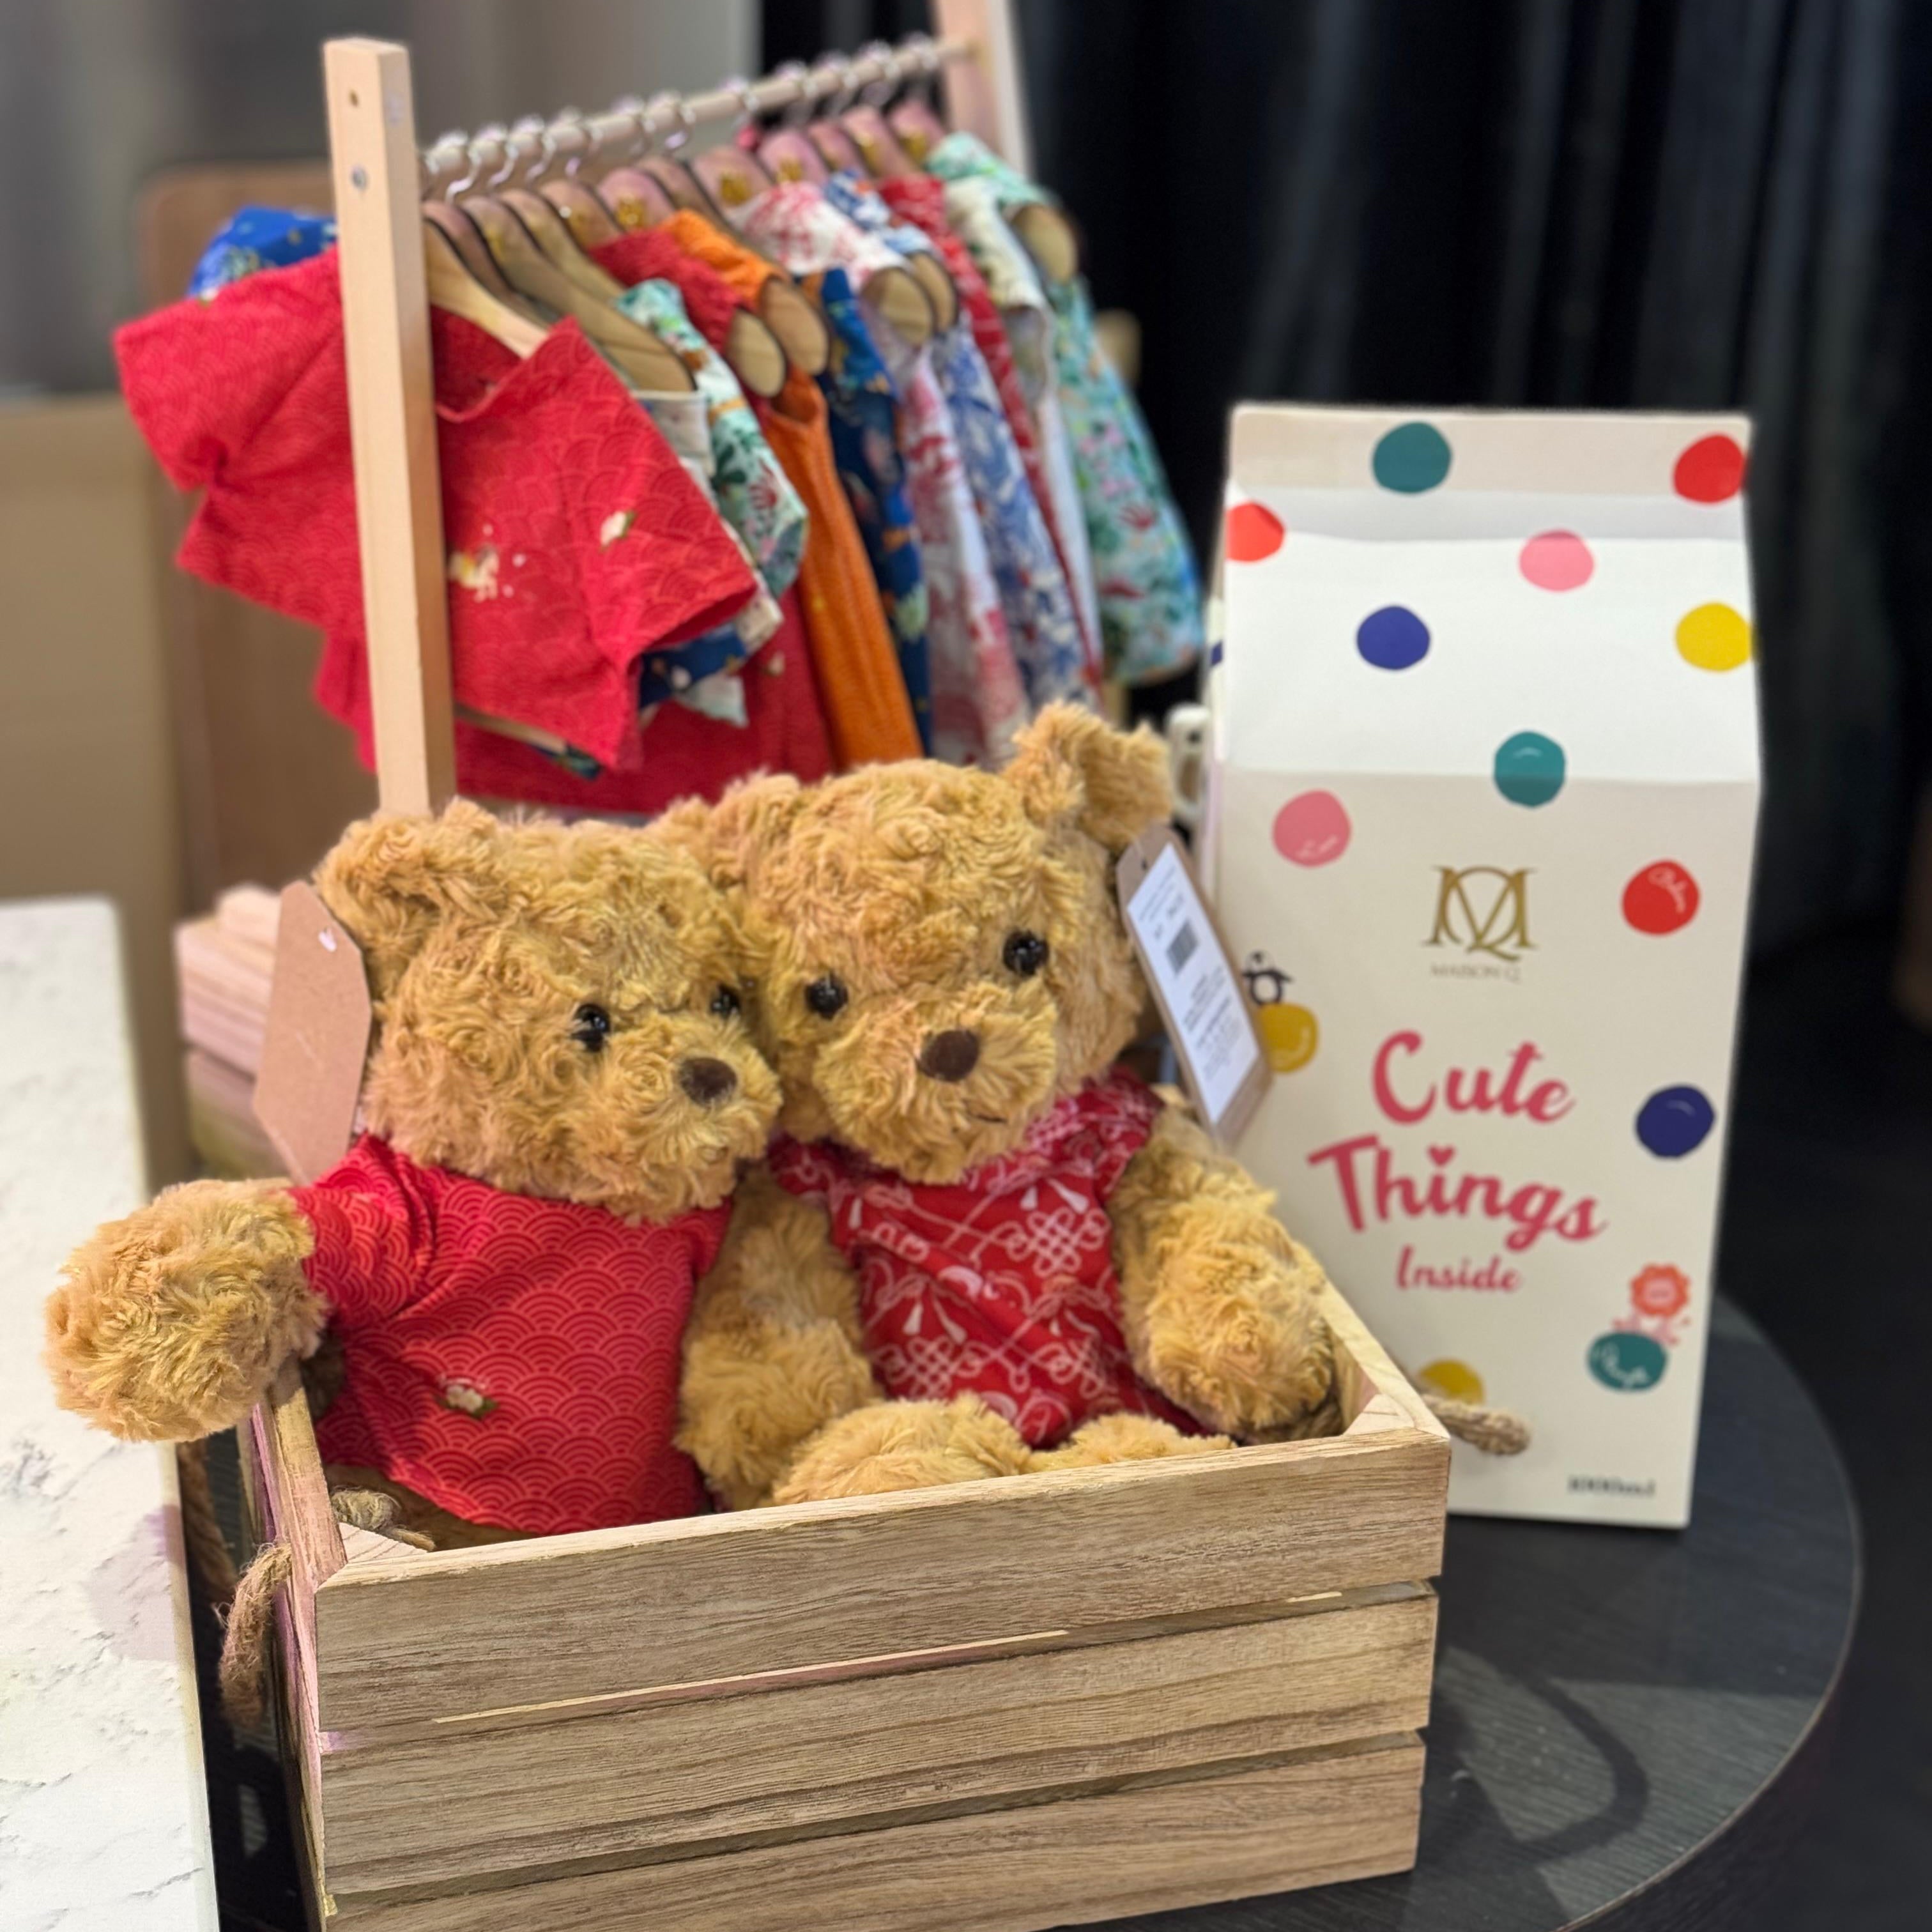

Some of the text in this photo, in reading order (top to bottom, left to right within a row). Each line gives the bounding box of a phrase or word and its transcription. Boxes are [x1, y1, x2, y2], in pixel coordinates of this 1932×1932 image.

[1430, 964, 1521, 983] MAISON Q
[1371, 1029, 1575, 1125] Cute
[1306, 1133, 1607, 1253] Things
[1397, 1245, 1521, 1292] Inside
